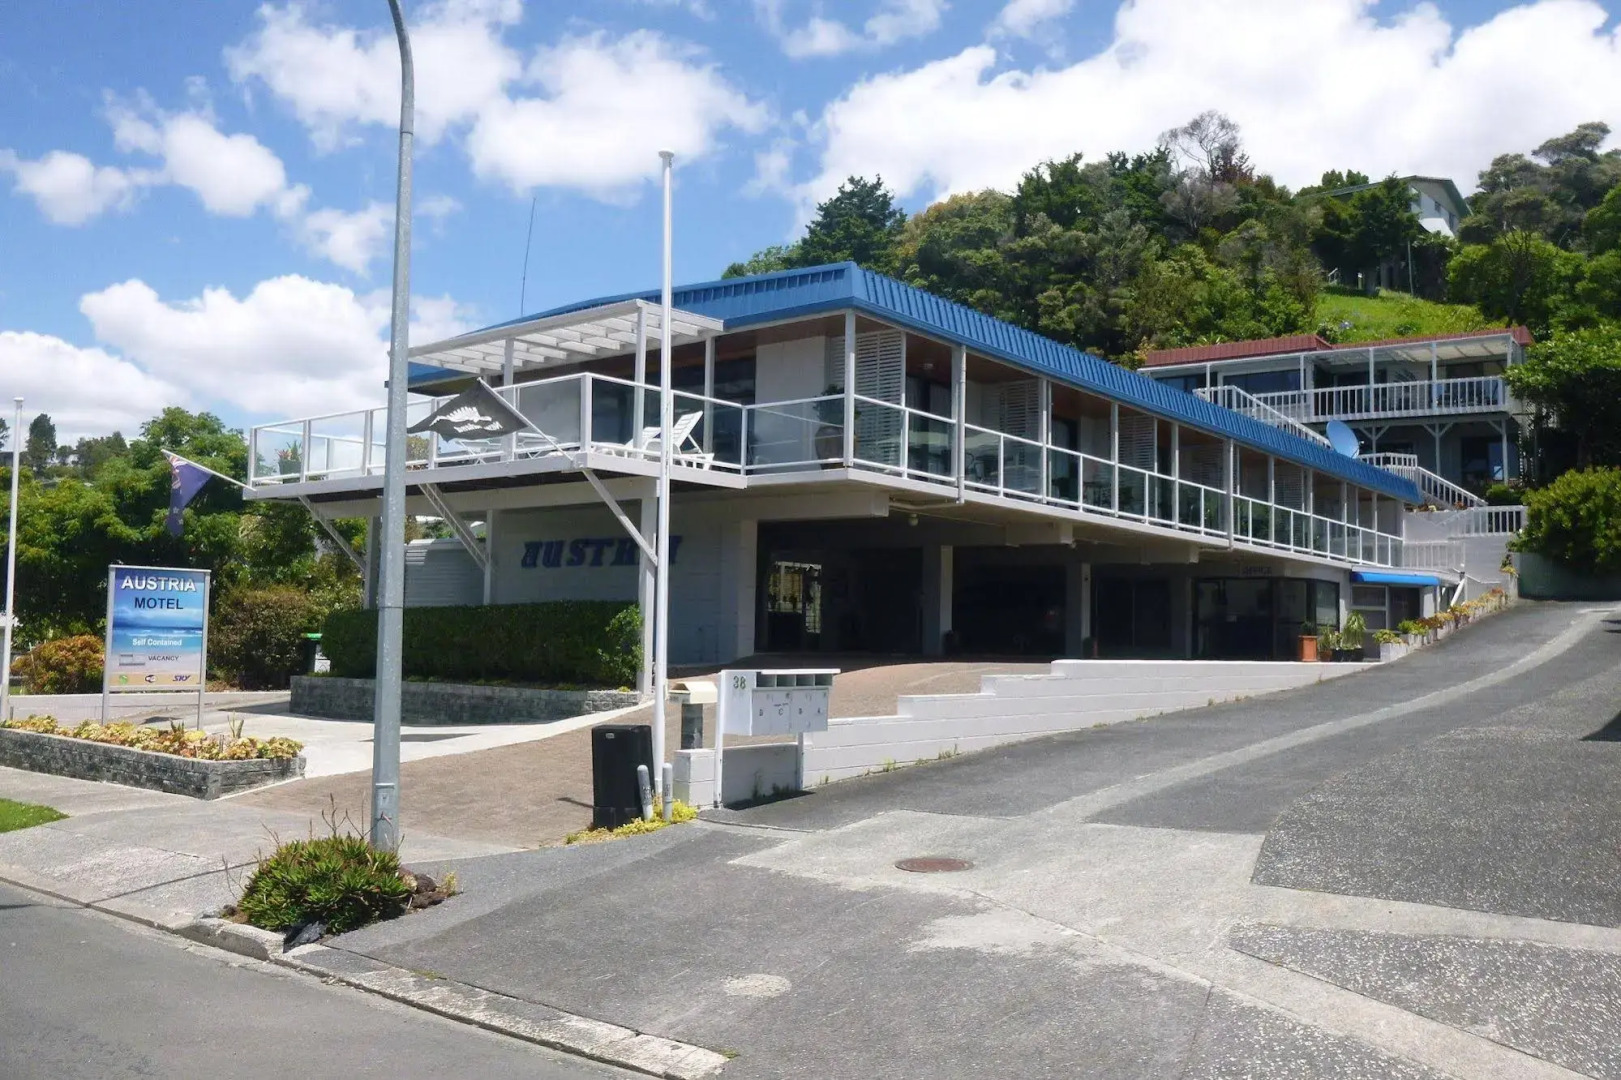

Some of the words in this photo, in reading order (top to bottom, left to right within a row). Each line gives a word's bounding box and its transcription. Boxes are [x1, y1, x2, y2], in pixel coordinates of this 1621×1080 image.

[521, 535, 682, 568] AUSTRA
[121, 575, 197, 592] AUSTRIA
[134, 597, 184, 610] MOTEL
[132, 638, 146, 646] Self
[147, 638, 183, 646] Contained
[733, 675, 746, 689] 38
[778, 708, 784, 716] C
